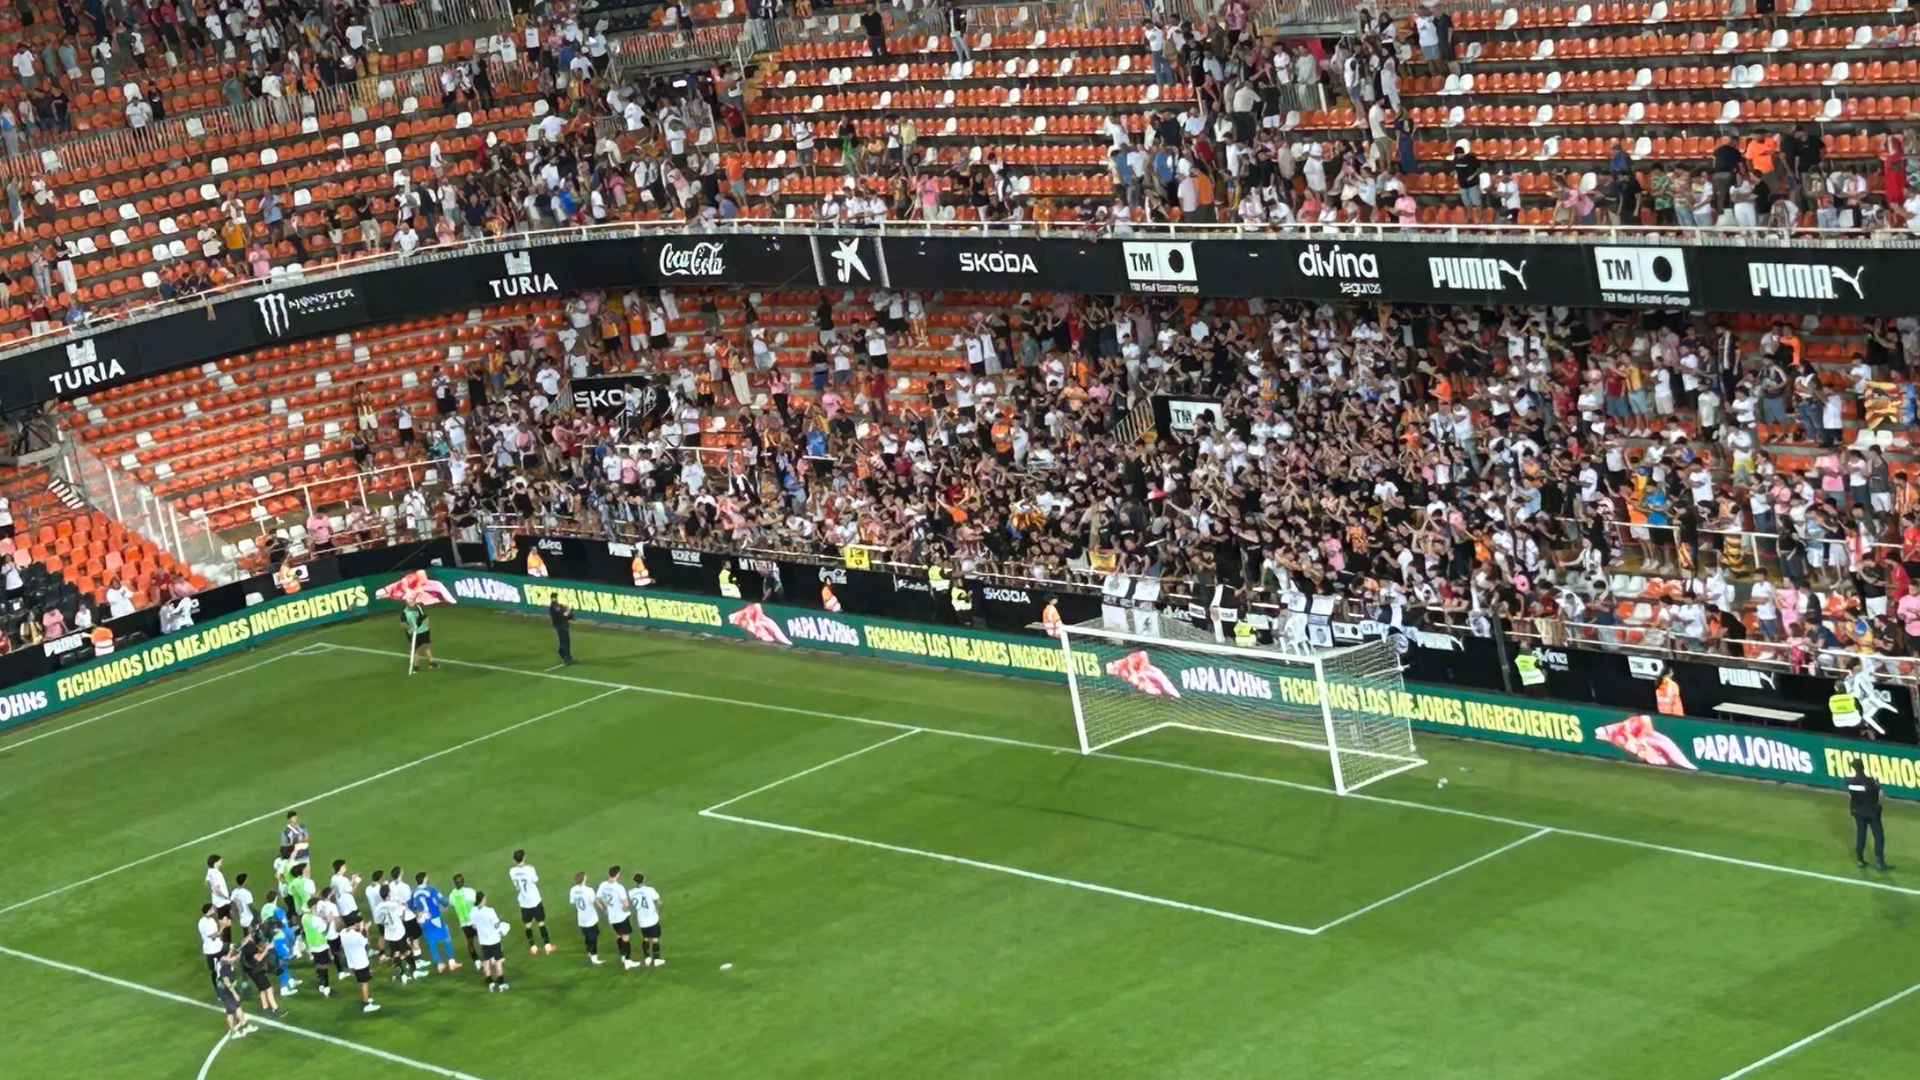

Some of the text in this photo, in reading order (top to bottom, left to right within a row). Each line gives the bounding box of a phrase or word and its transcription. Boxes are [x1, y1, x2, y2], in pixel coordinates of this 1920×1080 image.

[1129, 253, 1153, 272] TM
[1299, 243, 1379, 278] divina
[1428, 257, 1502, 290] PUMA
[1602, 259, 1633, 281] TM
[488, 272, 559, 298] TURIA
[1748, 263, 1835, 299] PUMA
[288, 288, 355, 310] MONSTER
[49, 358, 126, 394] TURIA
[57, 585, 369, 701] FICHAMOS LOS MEJORES INGREDIENTES
[864, 625, 927, 655] FICHAMOS
[926, 633, 951, 659] LOS
[949, 636, 1010, 667] MEJORES
[1358, 686, 1391, 716] LOS
[1389, 690, 1465, 727] MEJORES
[1464, 701, 1583, 744] INGREDIENTES
